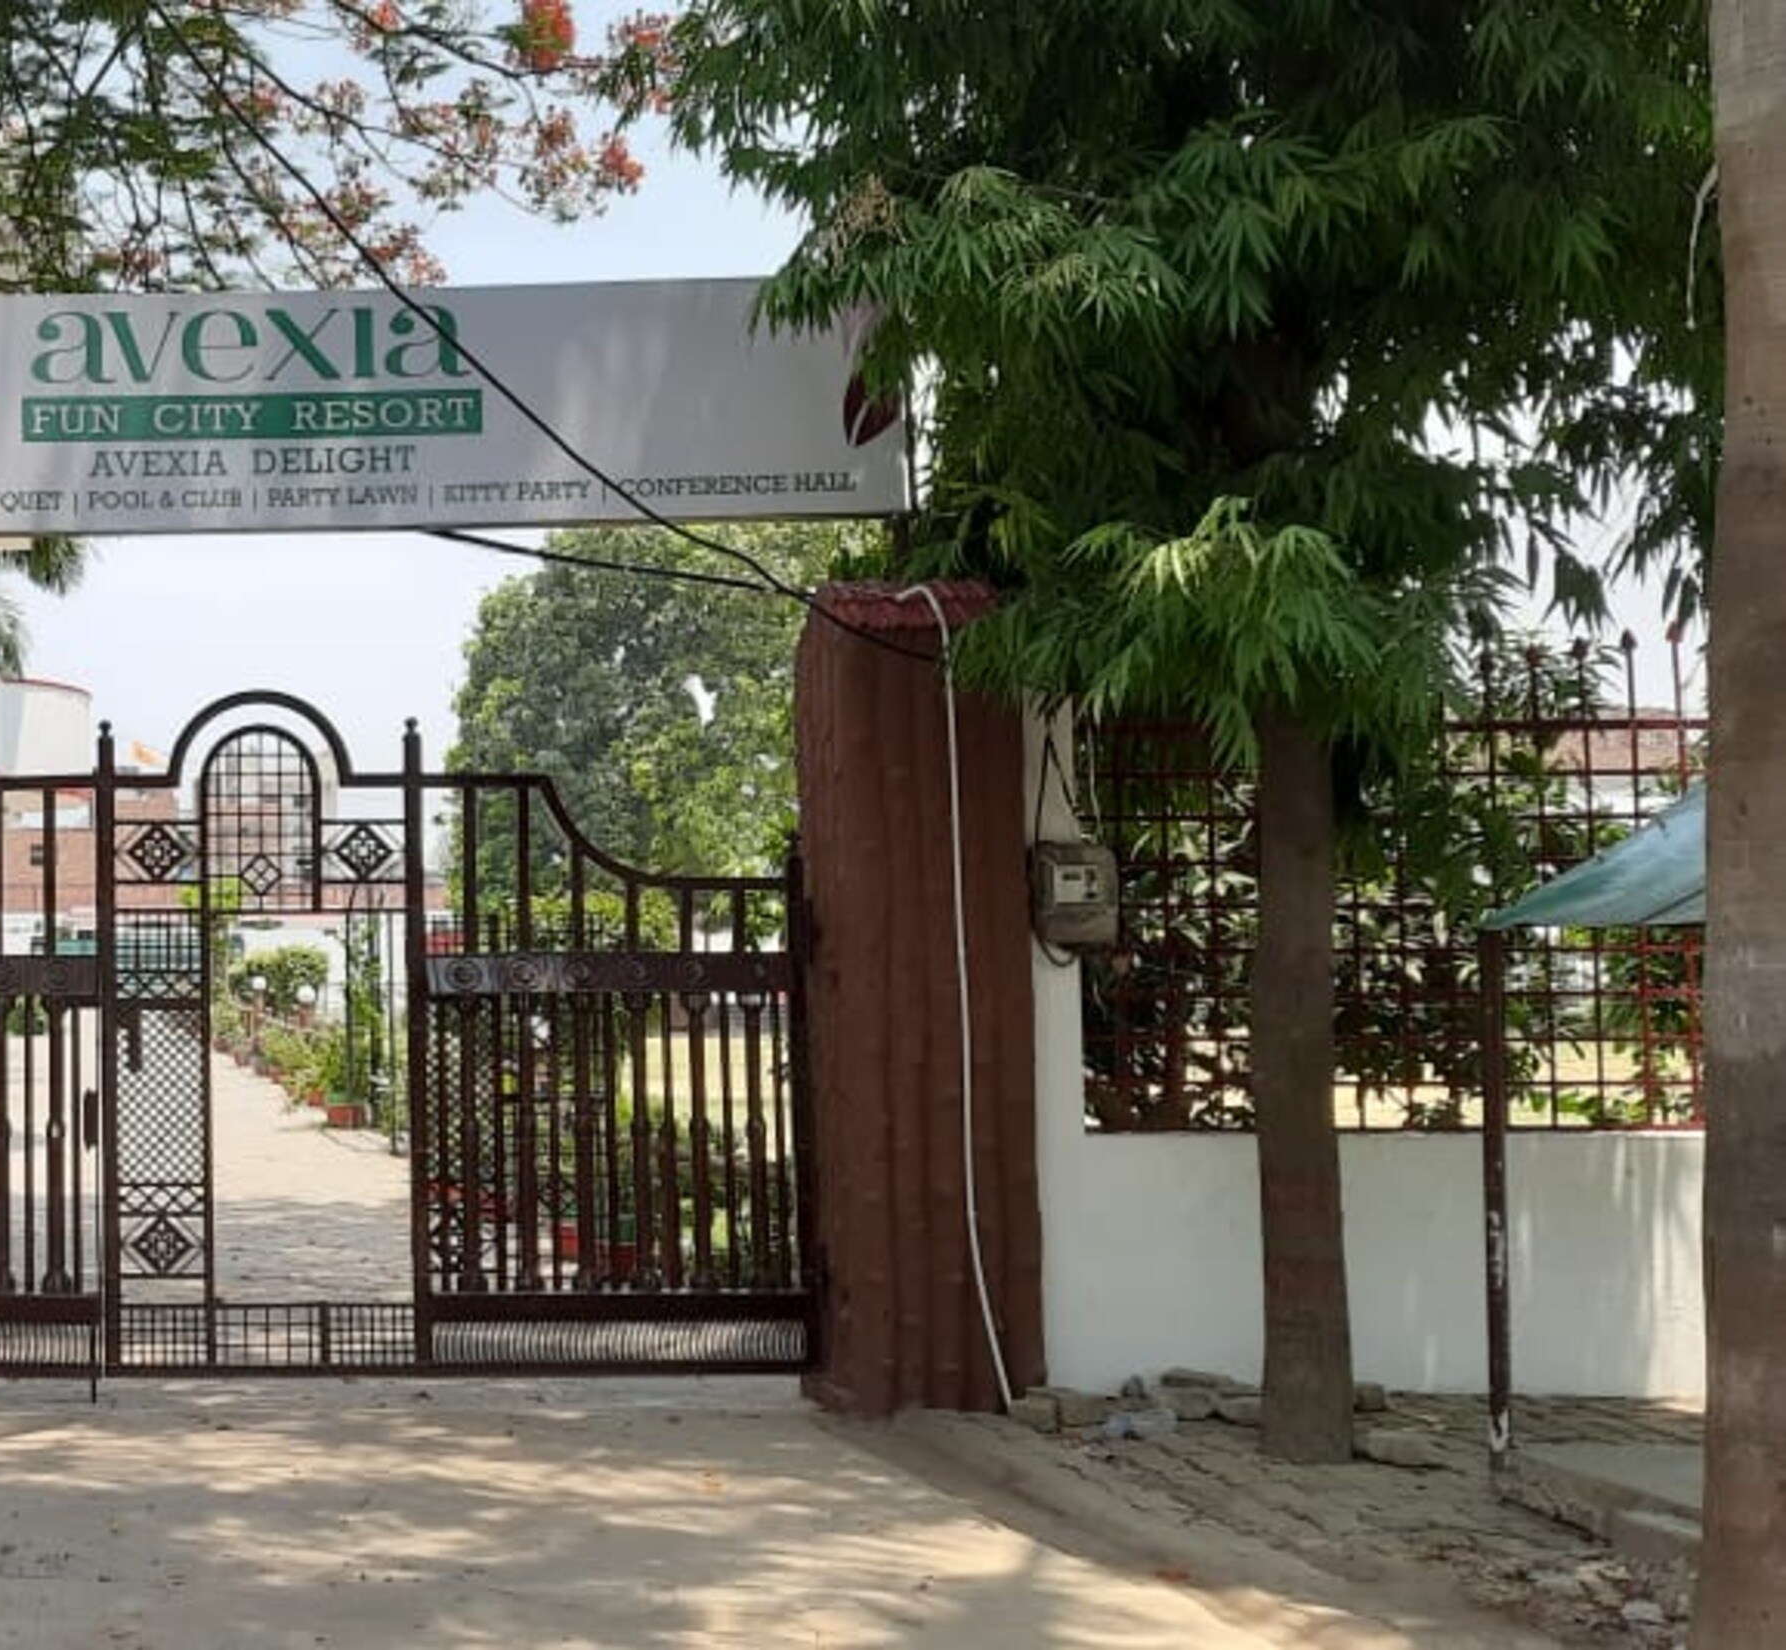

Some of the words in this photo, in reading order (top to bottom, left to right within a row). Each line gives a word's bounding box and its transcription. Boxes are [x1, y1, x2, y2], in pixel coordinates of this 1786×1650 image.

[30, 304, 472, 385] avexia
[31, 403, 122, 434] FUN
[153, 401, 263, 432] CITY
[291, 398, 474, 430] RESORT
[89, 449, 228, 478] AVEXIA
[251, 446, 416, 475] DELIGHT
[88, 489, 153, 510] POOL
[160, 490, 175, 509] &
[182, 488, 243, 508] CLUB
[267, 487, 341, 508] PARTY
[347, 485, 417, 505] LAWN
[443, 482, 510, 503] KITTY
[516, 480, 591, 501] PARTY
[617, 474, 787, 498] CONFERENCE
[794, 472, 857, 493] HALL
